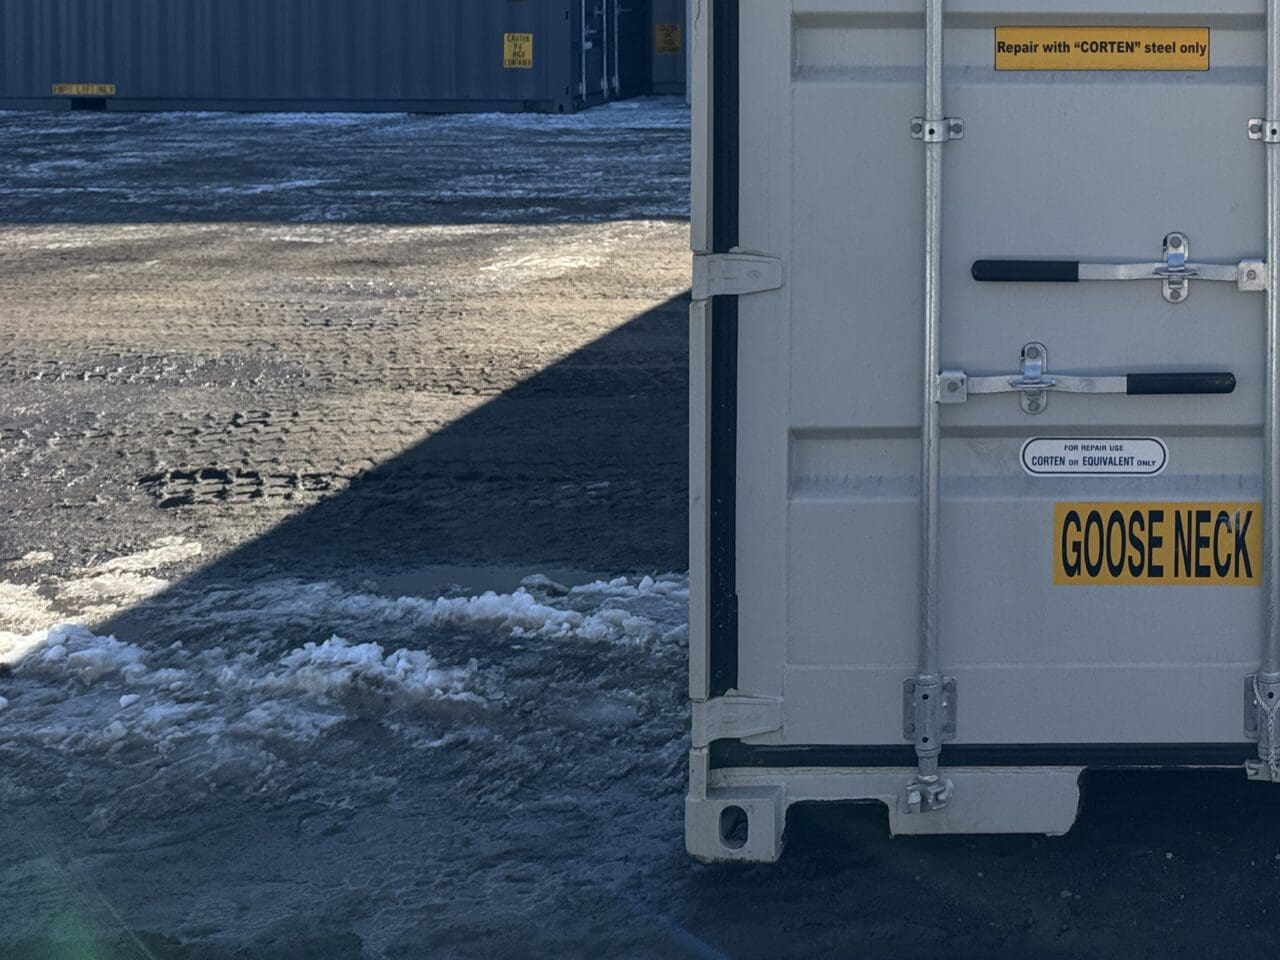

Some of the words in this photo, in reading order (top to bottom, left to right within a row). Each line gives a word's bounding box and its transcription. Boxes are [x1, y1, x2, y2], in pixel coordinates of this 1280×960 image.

[997, 41, 1039, 56] Repair
[1043, 41, 1070, 53] with
[1144, 42, 1176, 53] steel
[1179, 42, 1207, 57] only
[1064, 444, 1079, 452] FOR
[1081, 444, 1107, 452] REPAIR
[1109, 444, 1123, 452] USE
[1031, 456, 1065, 466] CORTEN
[1082, 456, 1135, 466] EQUIVALENT
[1136, 459, 1157, 467] ONLY
[1062, 509, 1164, 578] GOOSE
[1174, 509, 1254, 579] NECK
